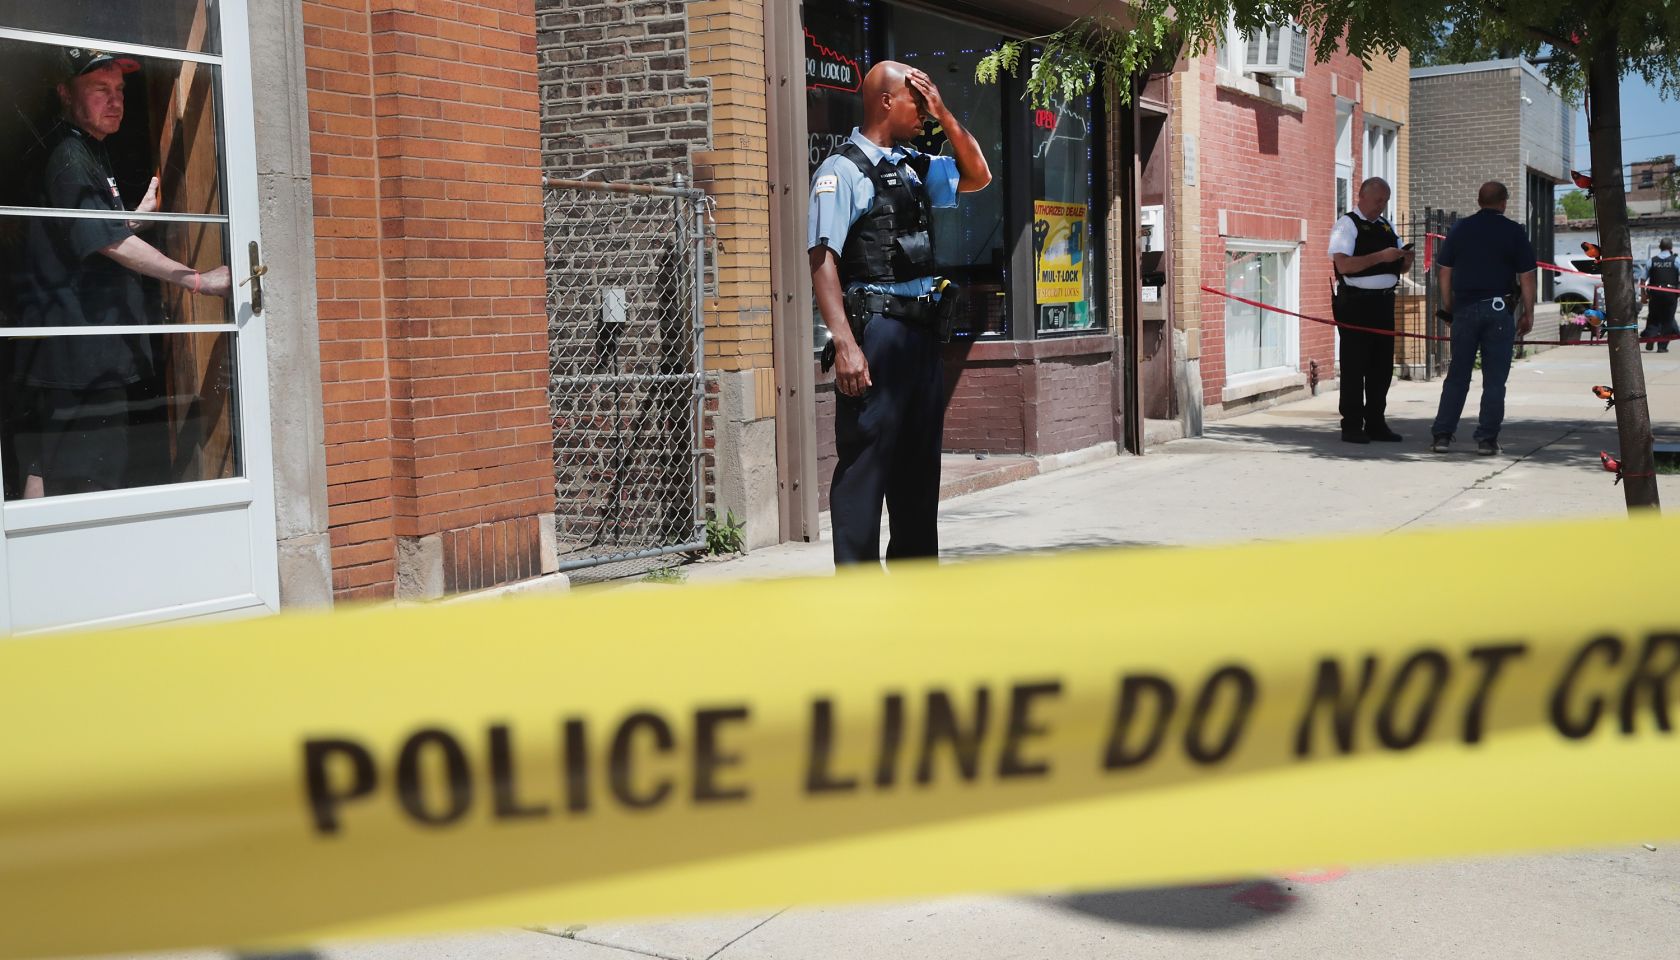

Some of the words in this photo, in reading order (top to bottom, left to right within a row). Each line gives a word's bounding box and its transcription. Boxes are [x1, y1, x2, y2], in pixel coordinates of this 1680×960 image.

[820, 60, 840, 80] LOCK
[1064, 287, 1080, 297] LOCKS
[302, 703, 752, 836] POLICE
[804, 680, 1062, 796] LINE
[1102, 664, 1258, 771] DO
[1293, 642, 1526, 760] NOT
[1547, 630, 1680, 740] CR
